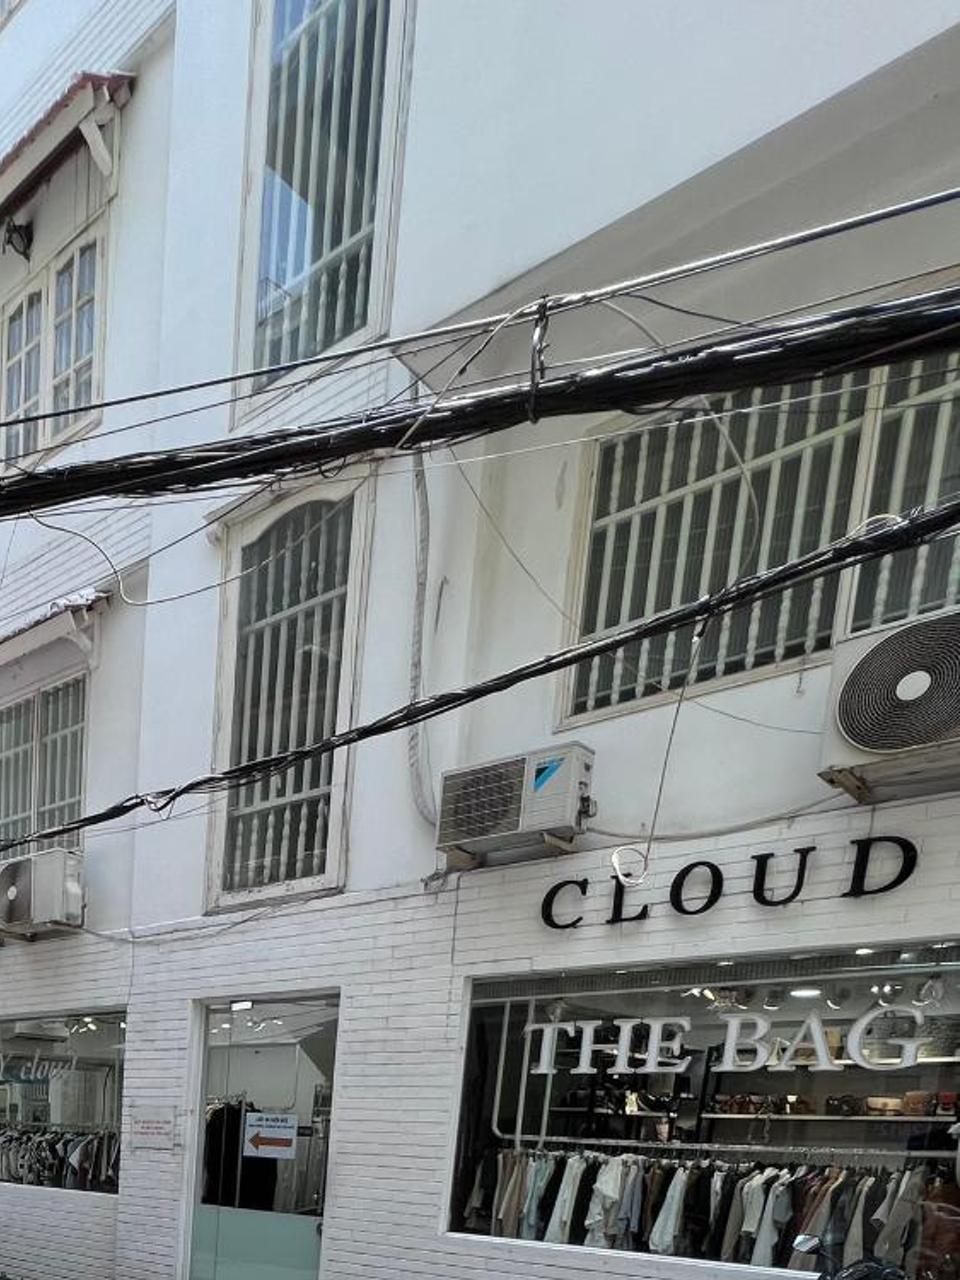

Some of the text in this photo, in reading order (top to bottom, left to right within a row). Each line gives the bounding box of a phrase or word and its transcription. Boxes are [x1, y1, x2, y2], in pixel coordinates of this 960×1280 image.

[541, 835, 919, 930] CLOUD
[525, 1005, 932, 1076] THE BAG
